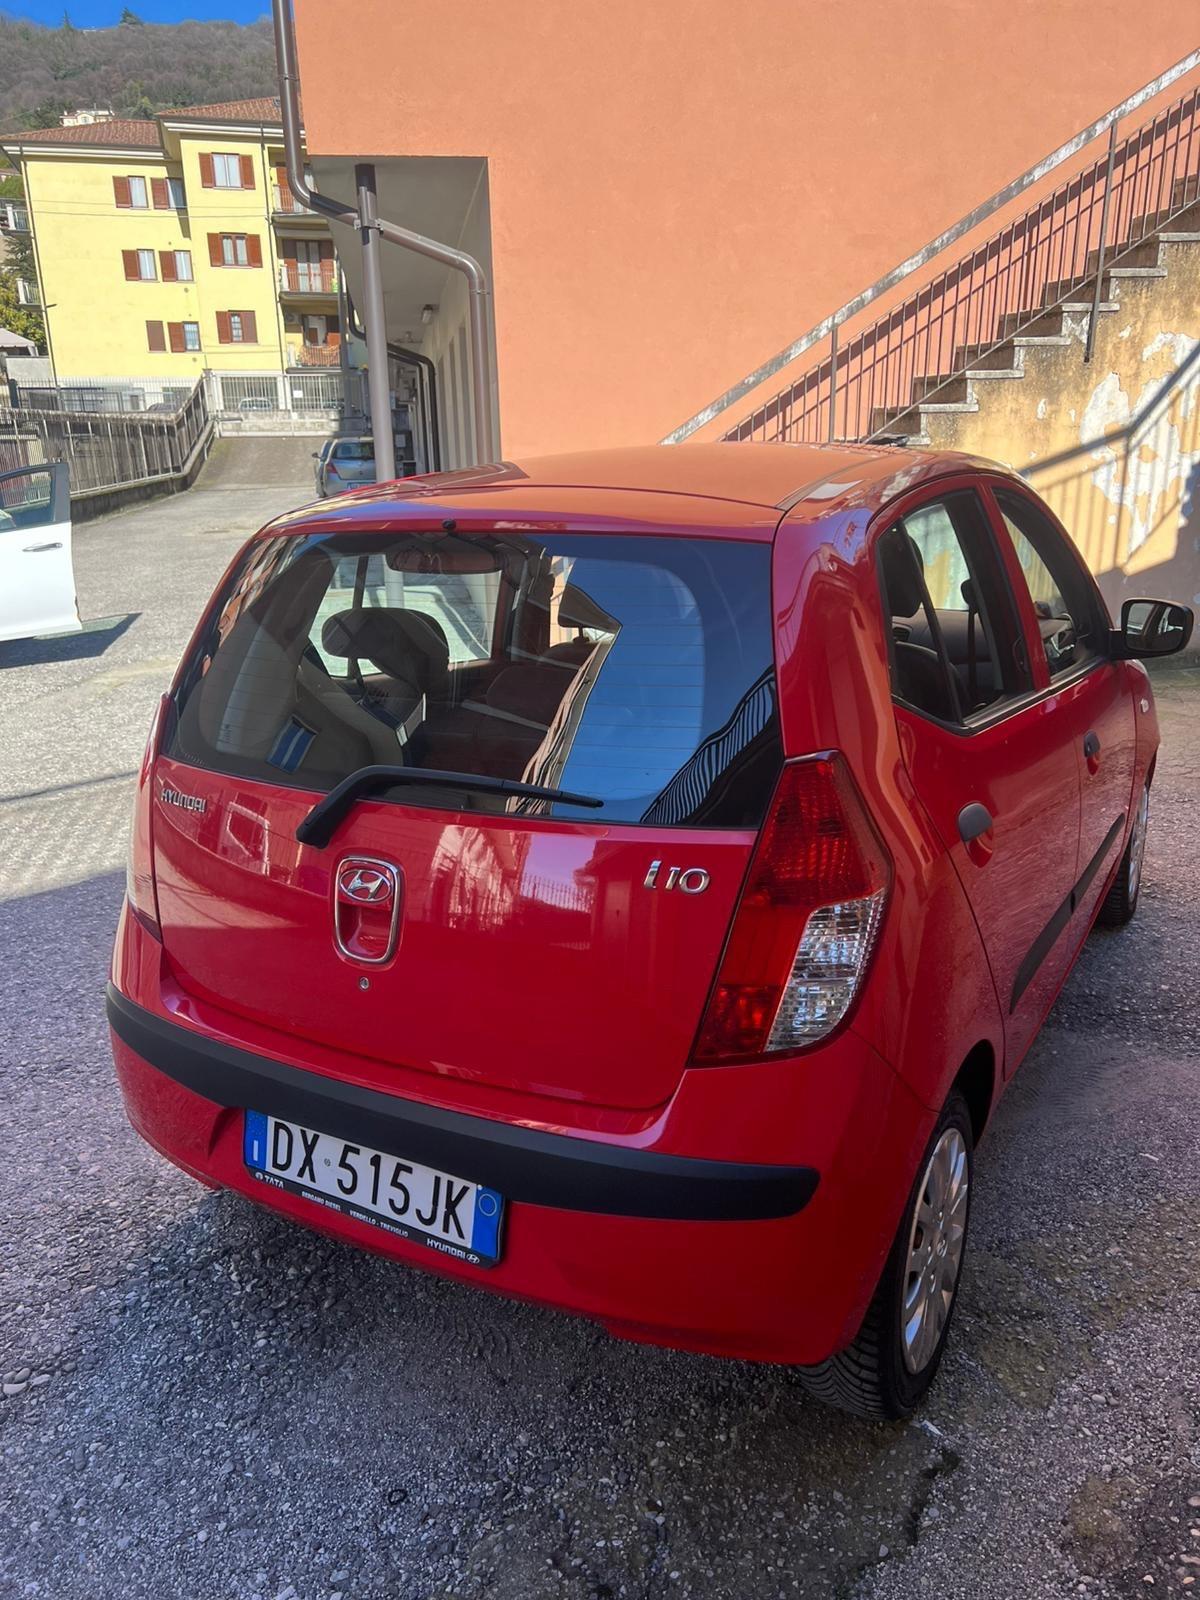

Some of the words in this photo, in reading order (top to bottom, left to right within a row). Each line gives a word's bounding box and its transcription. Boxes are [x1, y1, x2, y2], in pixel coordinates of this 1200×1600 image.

[161, 788, 207, 813] HYUNDAI
[271, 1121, 320, 1183] DX
[264, 1175, 284, 1189] TATA
[349, 1210, 377, 1225] VERDELLO
[380, 1222, 409, 1237] TREVIGLIO
[426, 1238, 466, 1259] HYUNDAI
